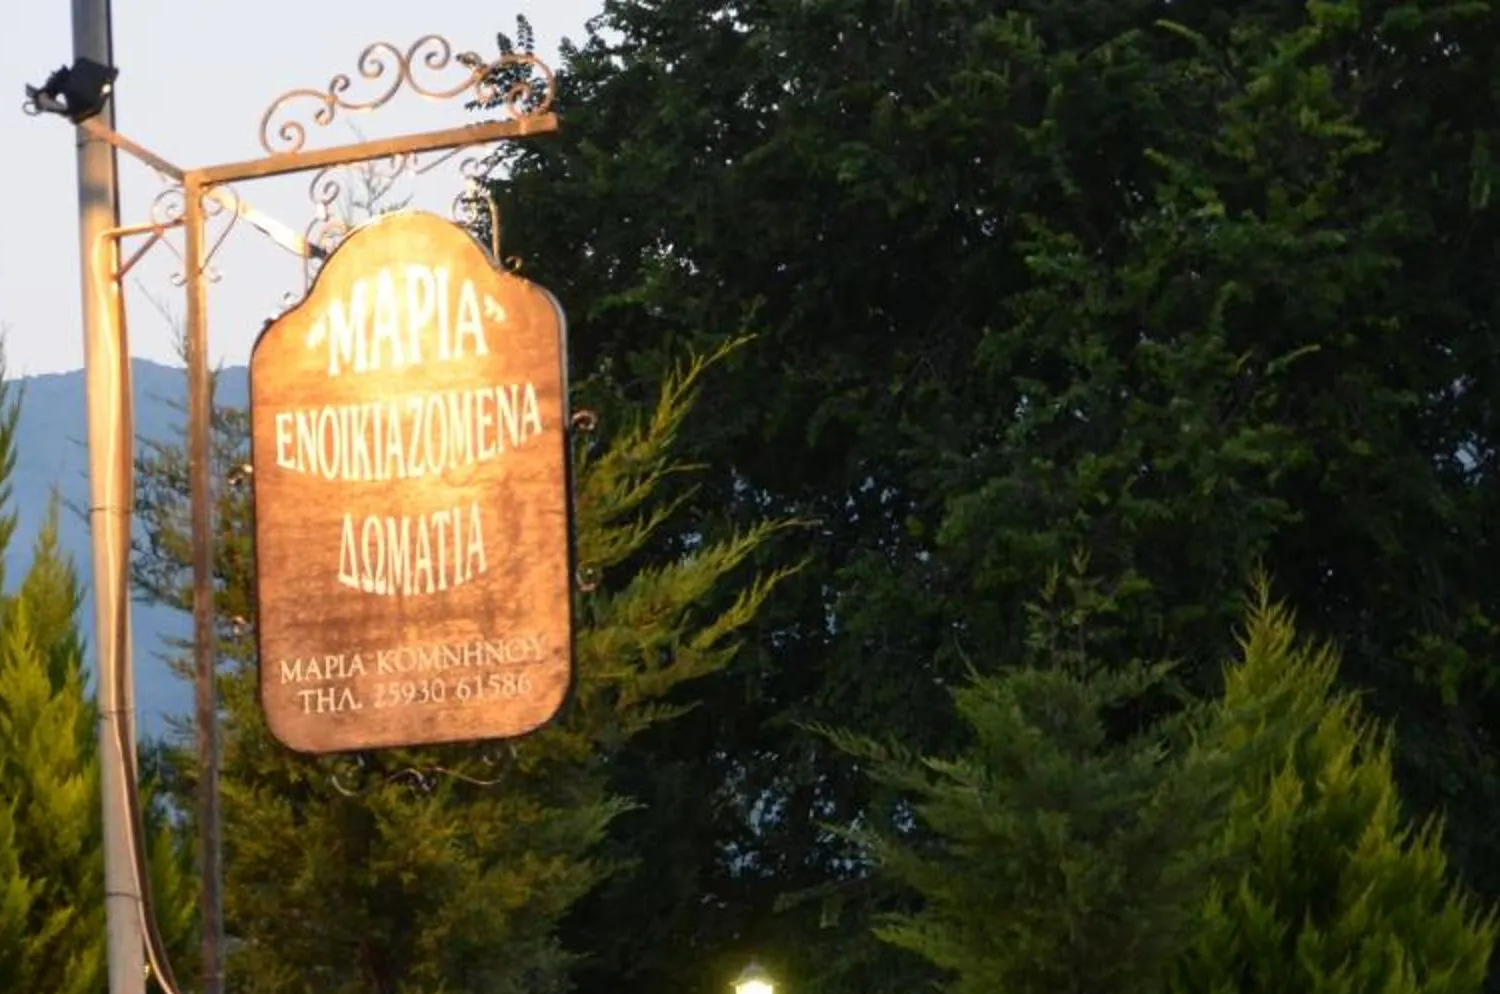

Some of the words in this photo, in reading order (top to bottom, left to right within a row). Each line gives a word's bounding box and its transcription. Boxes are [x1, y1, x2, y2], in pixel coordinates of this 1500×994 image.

[275, 381, 542, 482] ΕΝΟΙΚΙΑΖΟΜΕΝΑ
[337, 500, 488, 597] ΔΩΜΑΤΙΑ
[279, 654, 368, 685] ΜΑΡΙΑ
[375, 637, 549, 676] ΚΟΜΝΗΝΟΥ
[298, 689, 363, 715] ΤΗΛ.
[373, 679, 446, 709] 25930
[456, 672, 534, 701] 61586
